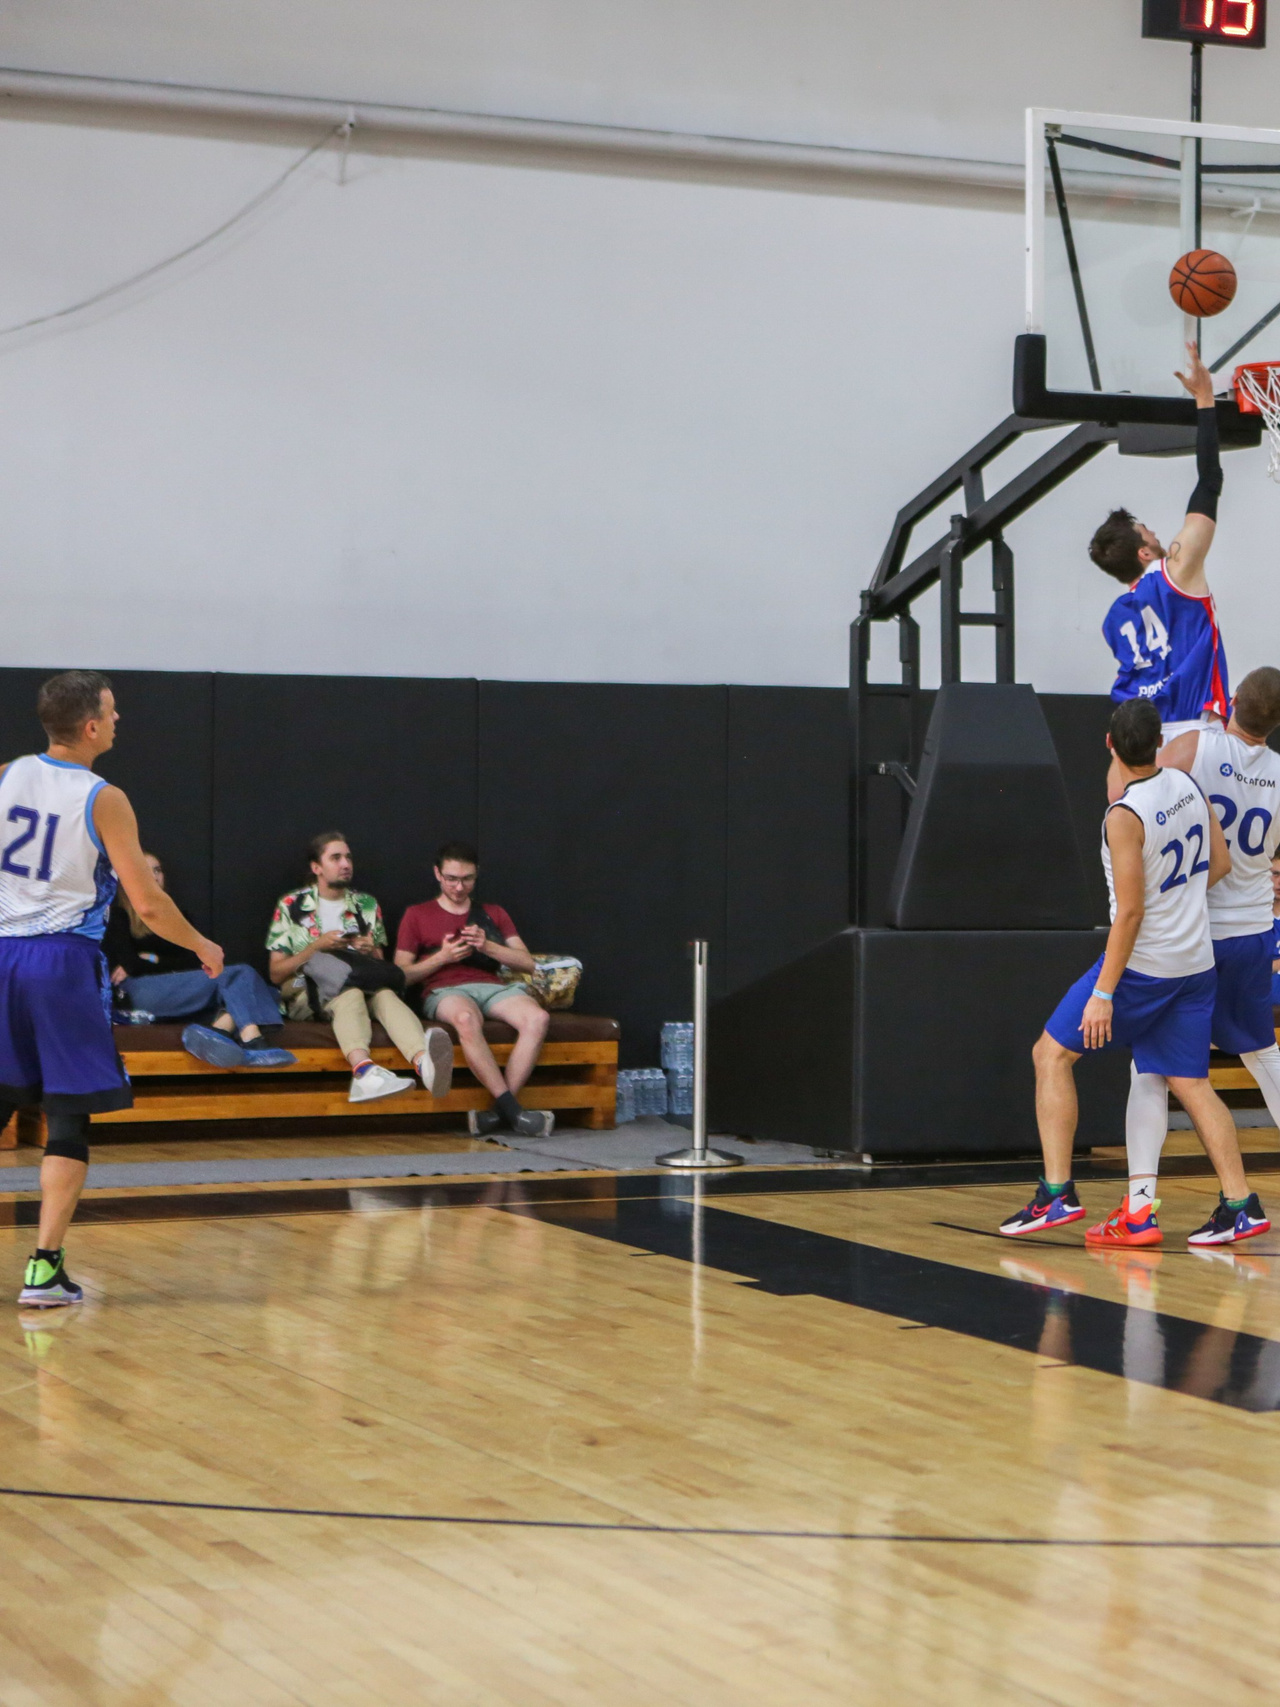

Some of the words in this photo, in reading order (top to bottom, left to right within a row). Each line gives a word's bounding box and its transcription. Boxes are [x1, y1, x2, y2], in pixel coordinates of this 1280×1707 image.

[1119, 605, 1172, 670] 14
[0, 804, 61, 882] 21
[1160, 823, 1209, 894] 22
[1208, 794, 1273, 857] 20
